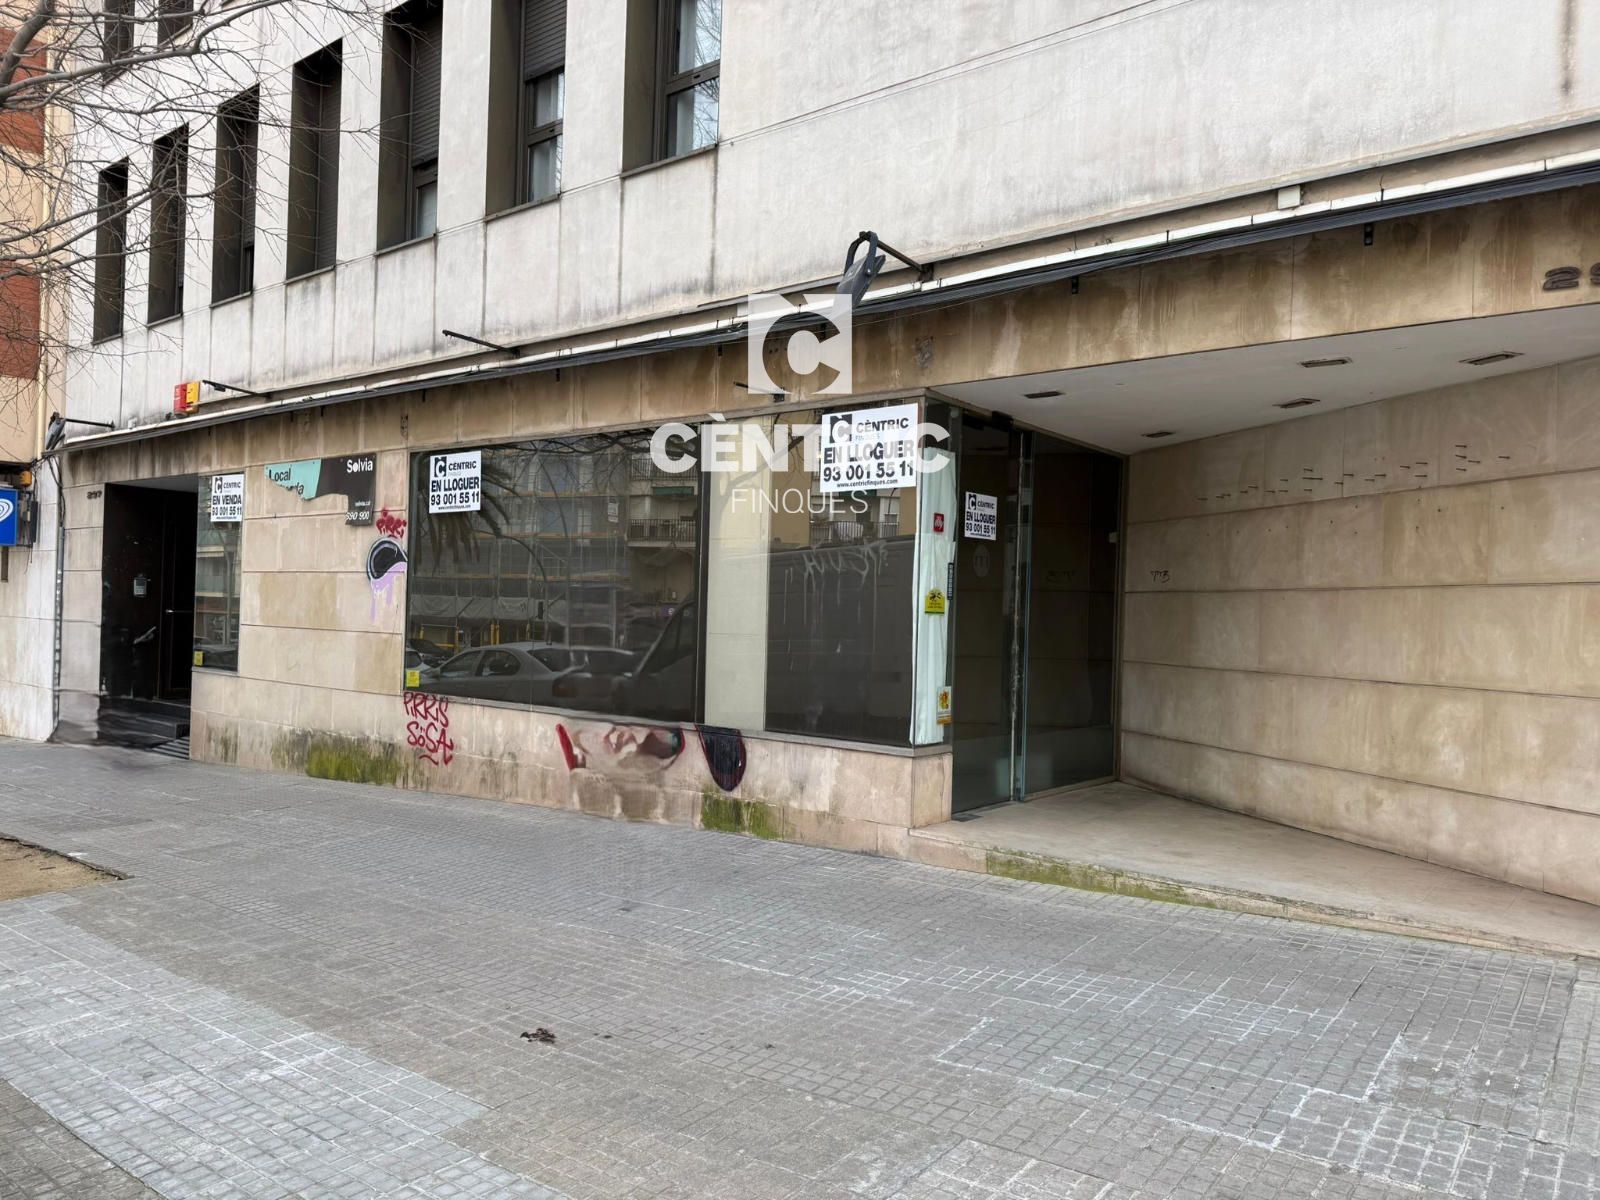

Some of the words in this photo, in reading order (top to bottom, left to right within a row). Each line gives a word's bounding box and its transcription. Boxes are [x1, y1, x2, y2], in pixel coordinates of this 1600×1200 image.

[1543, 263, 1600, 291] 2
[856, 417, 909, 434] CÈNTRIC
[823, 446, 843, 465] EN
[847, 439, 915, 463] LLOGUER
[346, 457, 374, 473] Solvia
[823, 465, 842, 482] 93
[846, 463, 871, 481] 001
[876, 461, 896, 479] 55
[900, 459, 914, 477] 11
[268, 467, 292, 482] Local
[431, 479, 442, 492] EN
[443, 476, 480, 492] LLOGUER
[212, 495, 221, 505] EN
[222, 494, 242, 505] VENDA
[430, 494, 441, 506] 93
[443, 493, 457, 505] 001
[459, 491, 470, 504] 55
[472, 490, 480, 503] 11
[229, 505, 237, 515] 55
[966, 511, 973, 521] EN
[973, 512, 996, 525] LLOGUER
[965, 522, 973, 532] 93
[973, 523, 983, 534] 001
[983, 524, 991, 534] 55
[990, 526, 996, 535] 11
